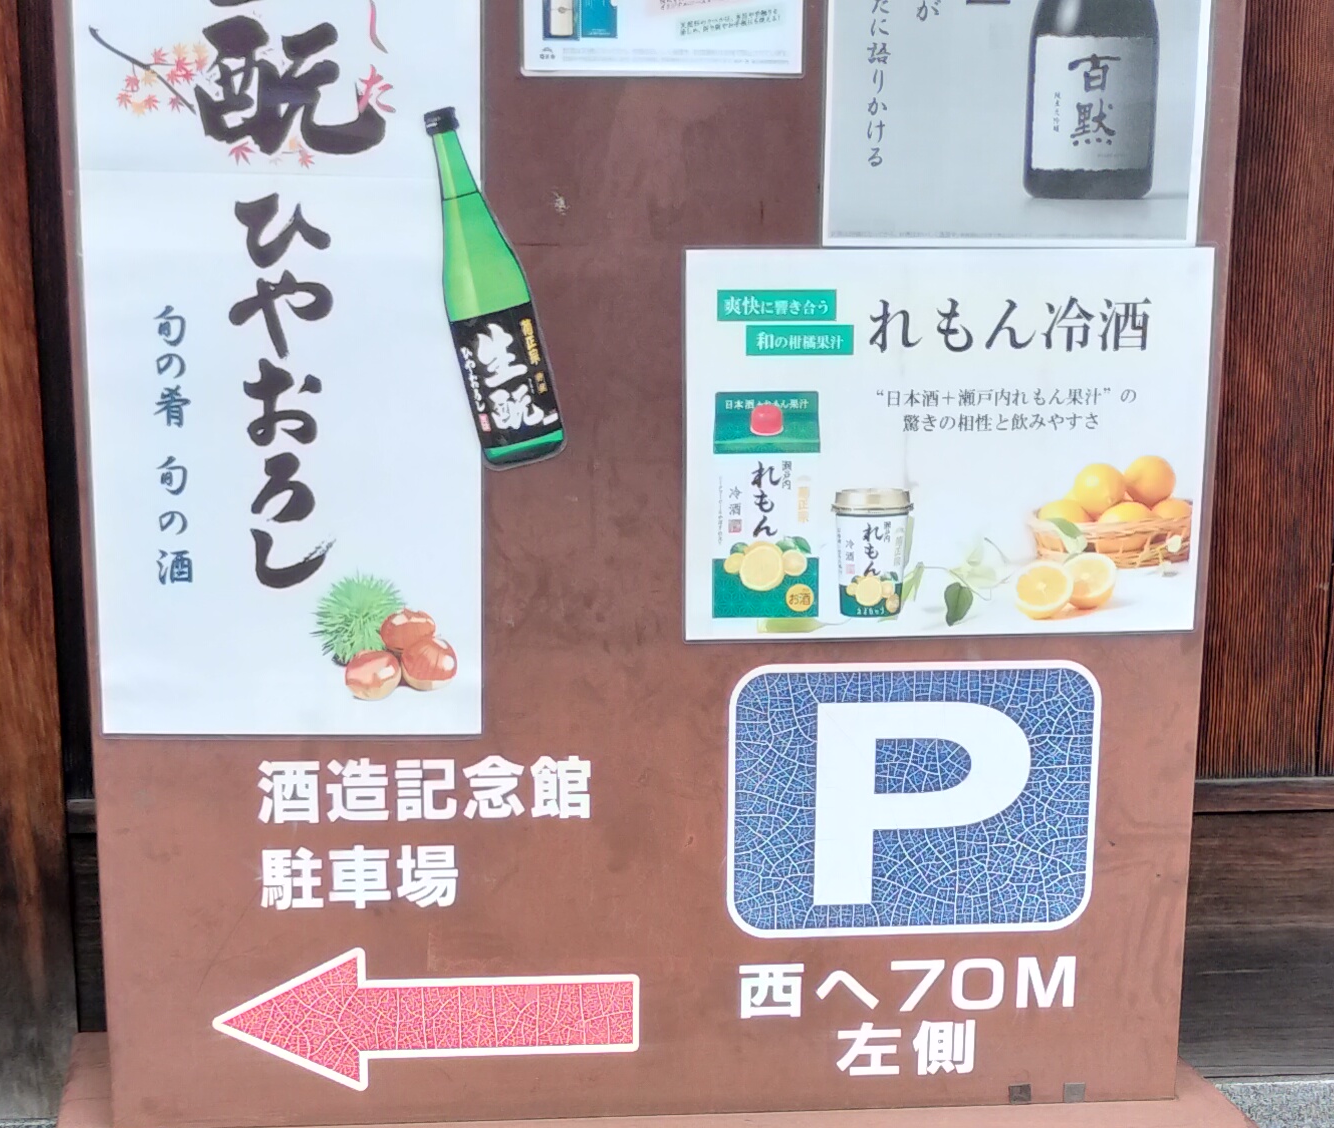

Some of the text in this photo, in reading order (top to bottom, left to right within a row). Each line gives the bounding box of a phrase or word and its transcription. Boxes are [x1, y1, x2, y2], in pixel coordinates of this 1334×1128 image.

[723, 295, 829, 316] 爽快に響き合う
[868, 295, 1153, 353] れもん冷酒
[229, 192, 338, 590] ひやおろし
[902, 412, 1100, 432] 驚きの相性と飲みやすさ
[153, 305, 195, 586] 旬の肴 旬の酒
[750, 460, 783, 538] れもん
[862, 522, 884, 577] れもん
[788, 593, 811, 607] お酒
[256, 754, 593, 825] 酒造記念館
[812, 700, 1032, 906] P
[259, 844, 459, 911] 駐車場
[835, 1019, 977, 1078] 左側
